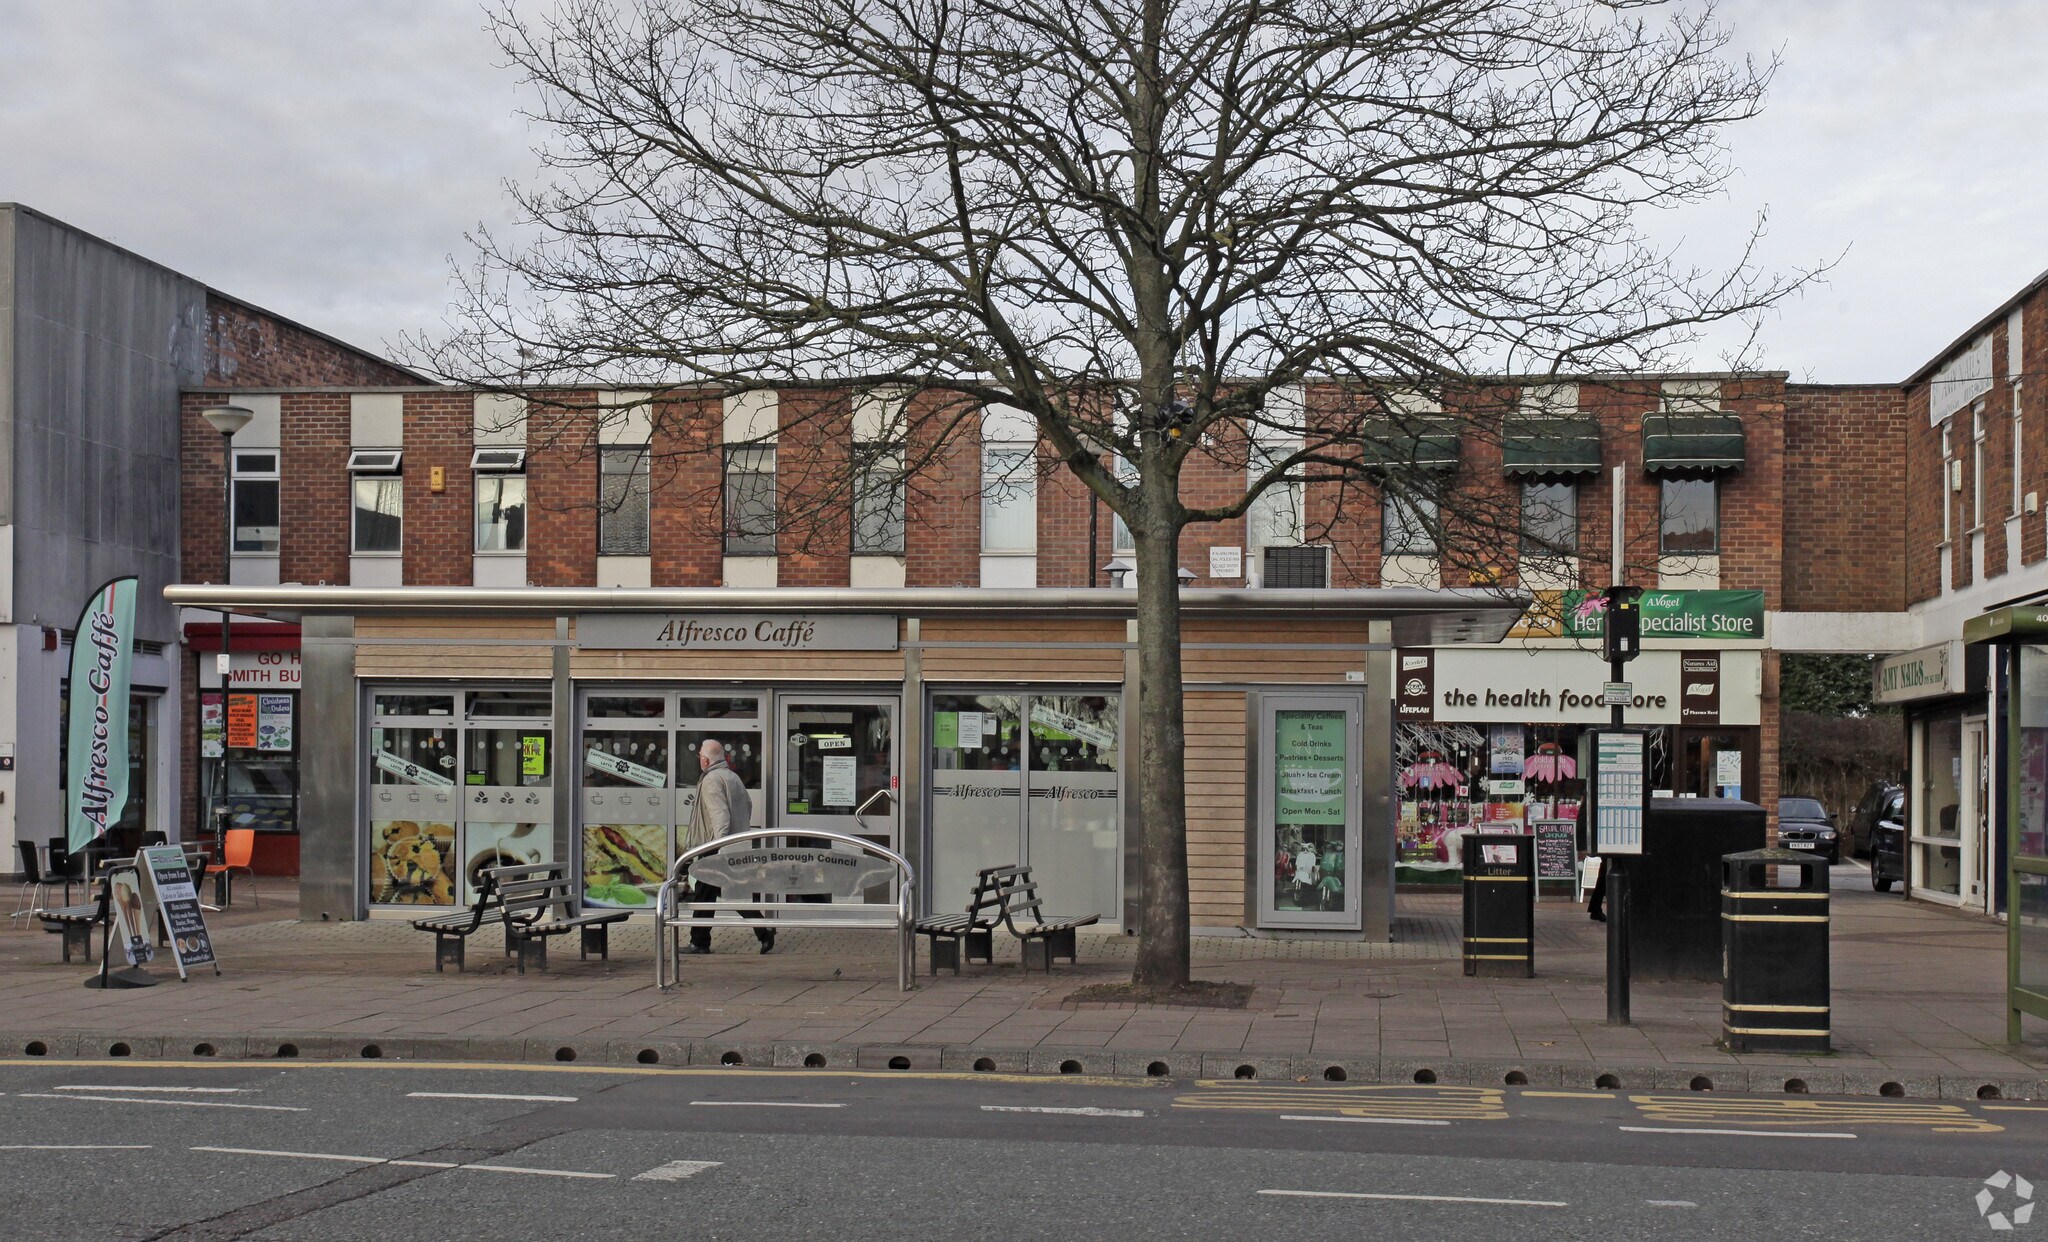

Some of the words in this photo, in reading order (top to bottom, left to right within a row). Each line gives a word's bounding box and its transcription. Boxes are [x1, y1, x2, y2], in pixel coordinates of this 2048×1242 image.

[1646, 594, 1680, 608] A.Vogel
[1574, 614, 1604, 631] Her
[1640, 614, 1706, 636] pecialist
[1708, 614, 1753, 632] Store
[657, 620, 748, 646] Alfresco
[754, 620, 815, 647] Caffé
[88, 611, 119, 695] Caffé
[258, 653, 282, 665] GO
[1883, 666, 1898, 692] AMY
[1900, 659, 1924, 688] NAILS
[262, 697, 290, 705] Christmas
[1444, 688, 1477, 707] the
[1485, 688, 1551, 707] health
[1624, 690, 1667, 707] ore
[1281, 712, 1314, 720] Speciality
[1316, 712, 1343, 720] Coffees
[81, 706, 115, 830] Alfresco
[949, 784, 1002, 800] Alfresco
[1045, 786, 1099, 801] Alfresco
[728, 854, 767, 867] Gedling
[770, 852, 814, 863] Borough
[817, 854, 857, 867] Council
[1487, 867, 1512, 876] Litter
